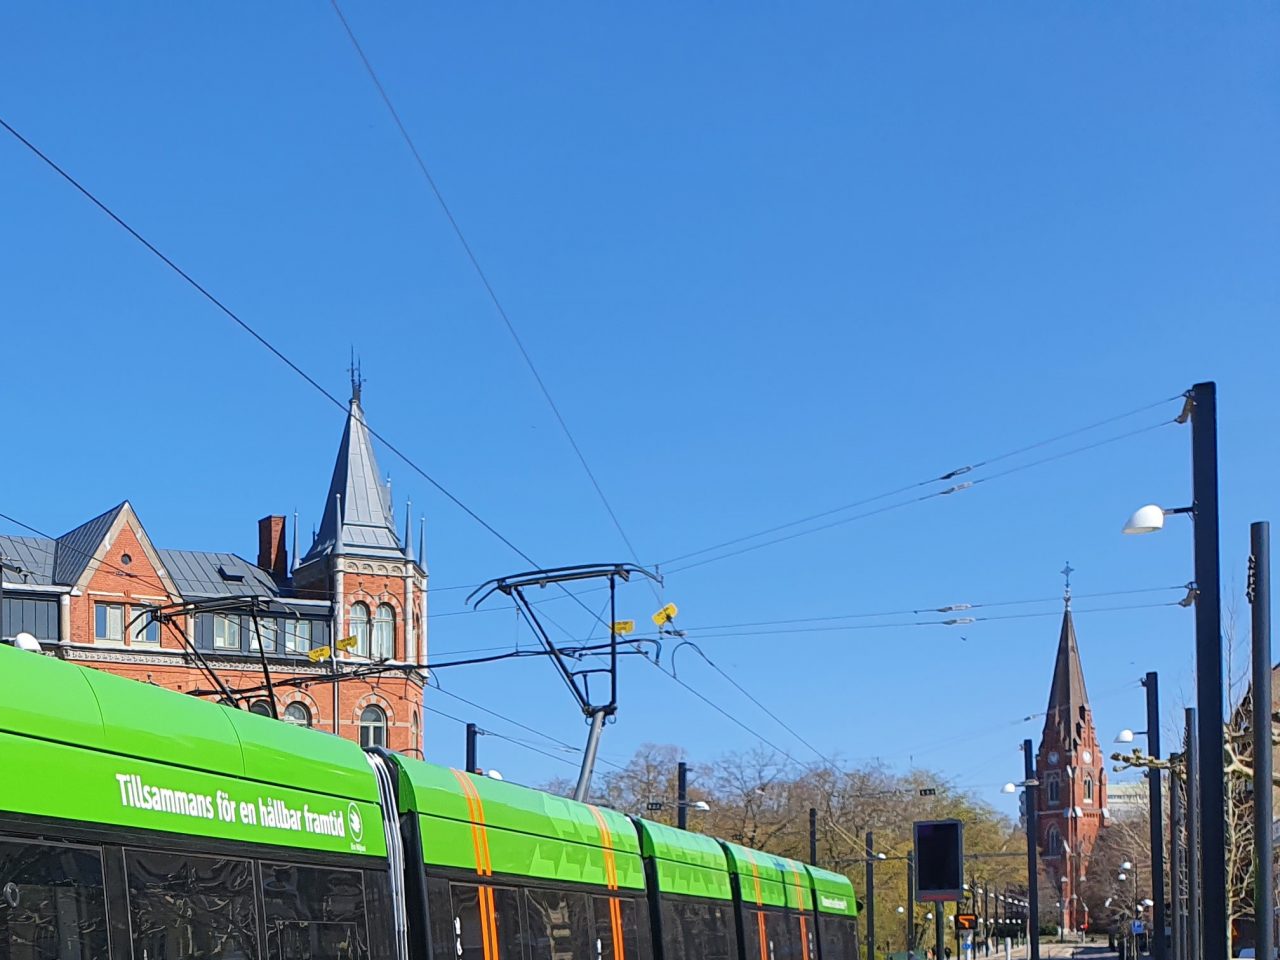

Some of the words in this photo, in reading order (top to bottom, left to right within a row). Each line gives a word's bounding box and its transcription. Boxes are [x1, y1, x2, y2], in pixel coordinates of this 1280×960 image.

[116, 773, 214, 820] Tillsammans
[216, 790, 236, 823] för
[240, 800, 257, 825] en
[258, 797, 301, 832] hållbar
[304, 804, 346, 838] framtid
